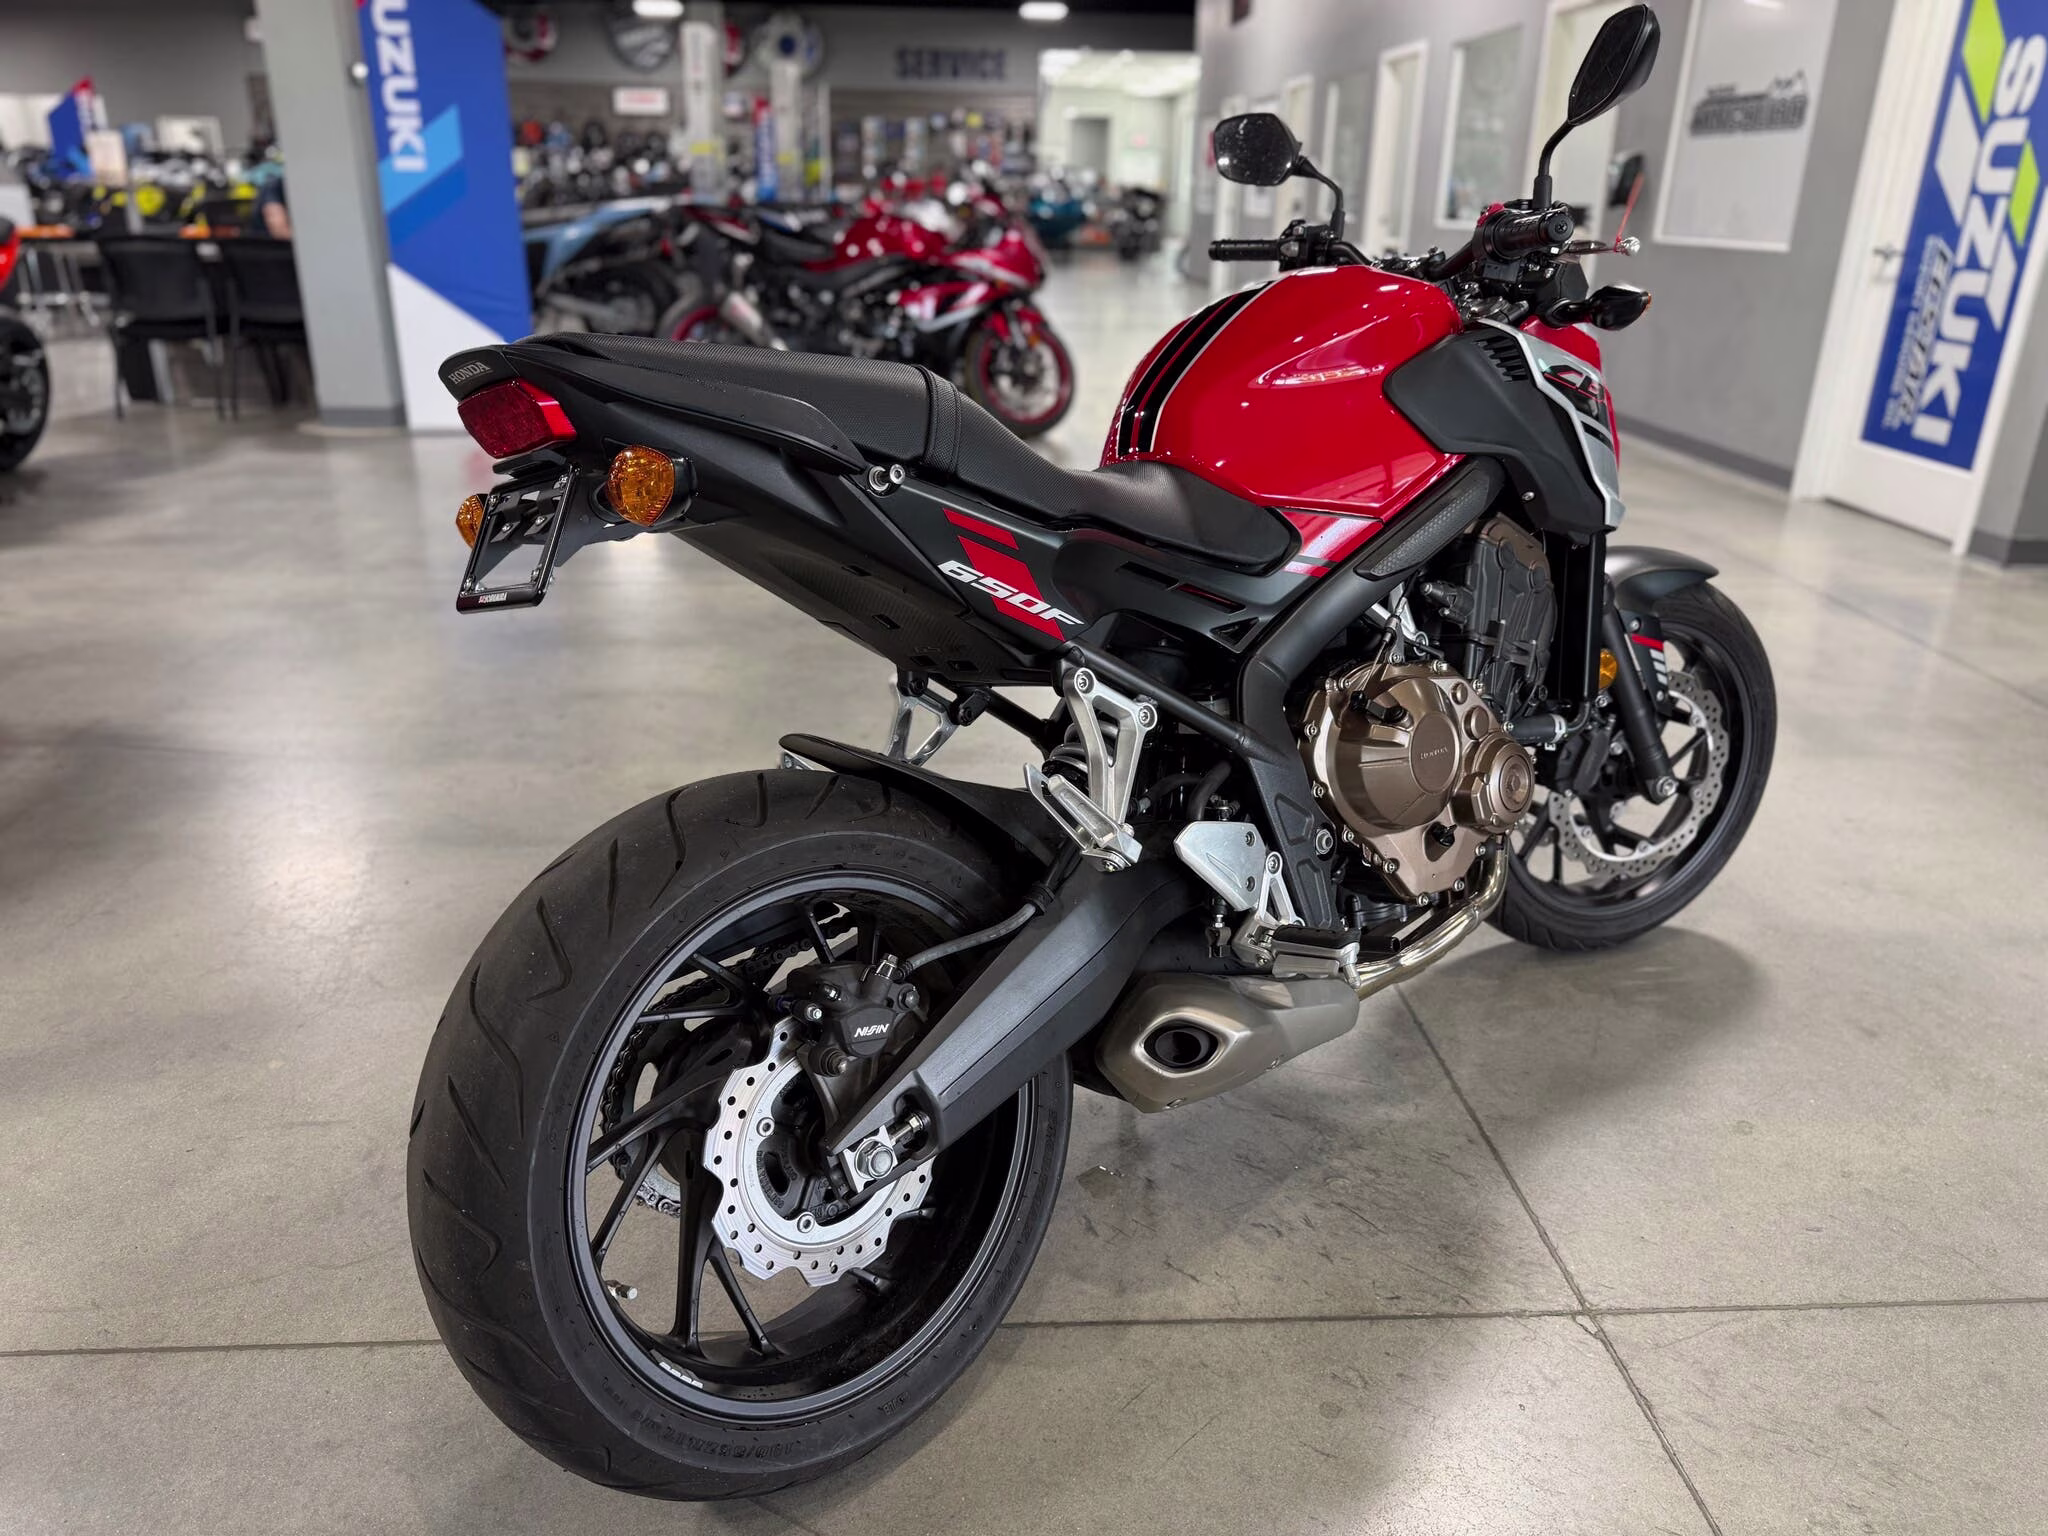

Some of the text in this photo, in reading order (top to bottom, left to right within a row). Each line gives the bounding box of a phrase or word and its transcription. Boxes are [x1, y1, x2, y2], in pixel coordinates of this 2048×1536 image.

[370, 0, 428, 172] UZUKI
[1911, 34, 2047, 446] SUZUKI
[448, 361, 493, 385] HONDA
[937, 560, 1085, 625] 650F
